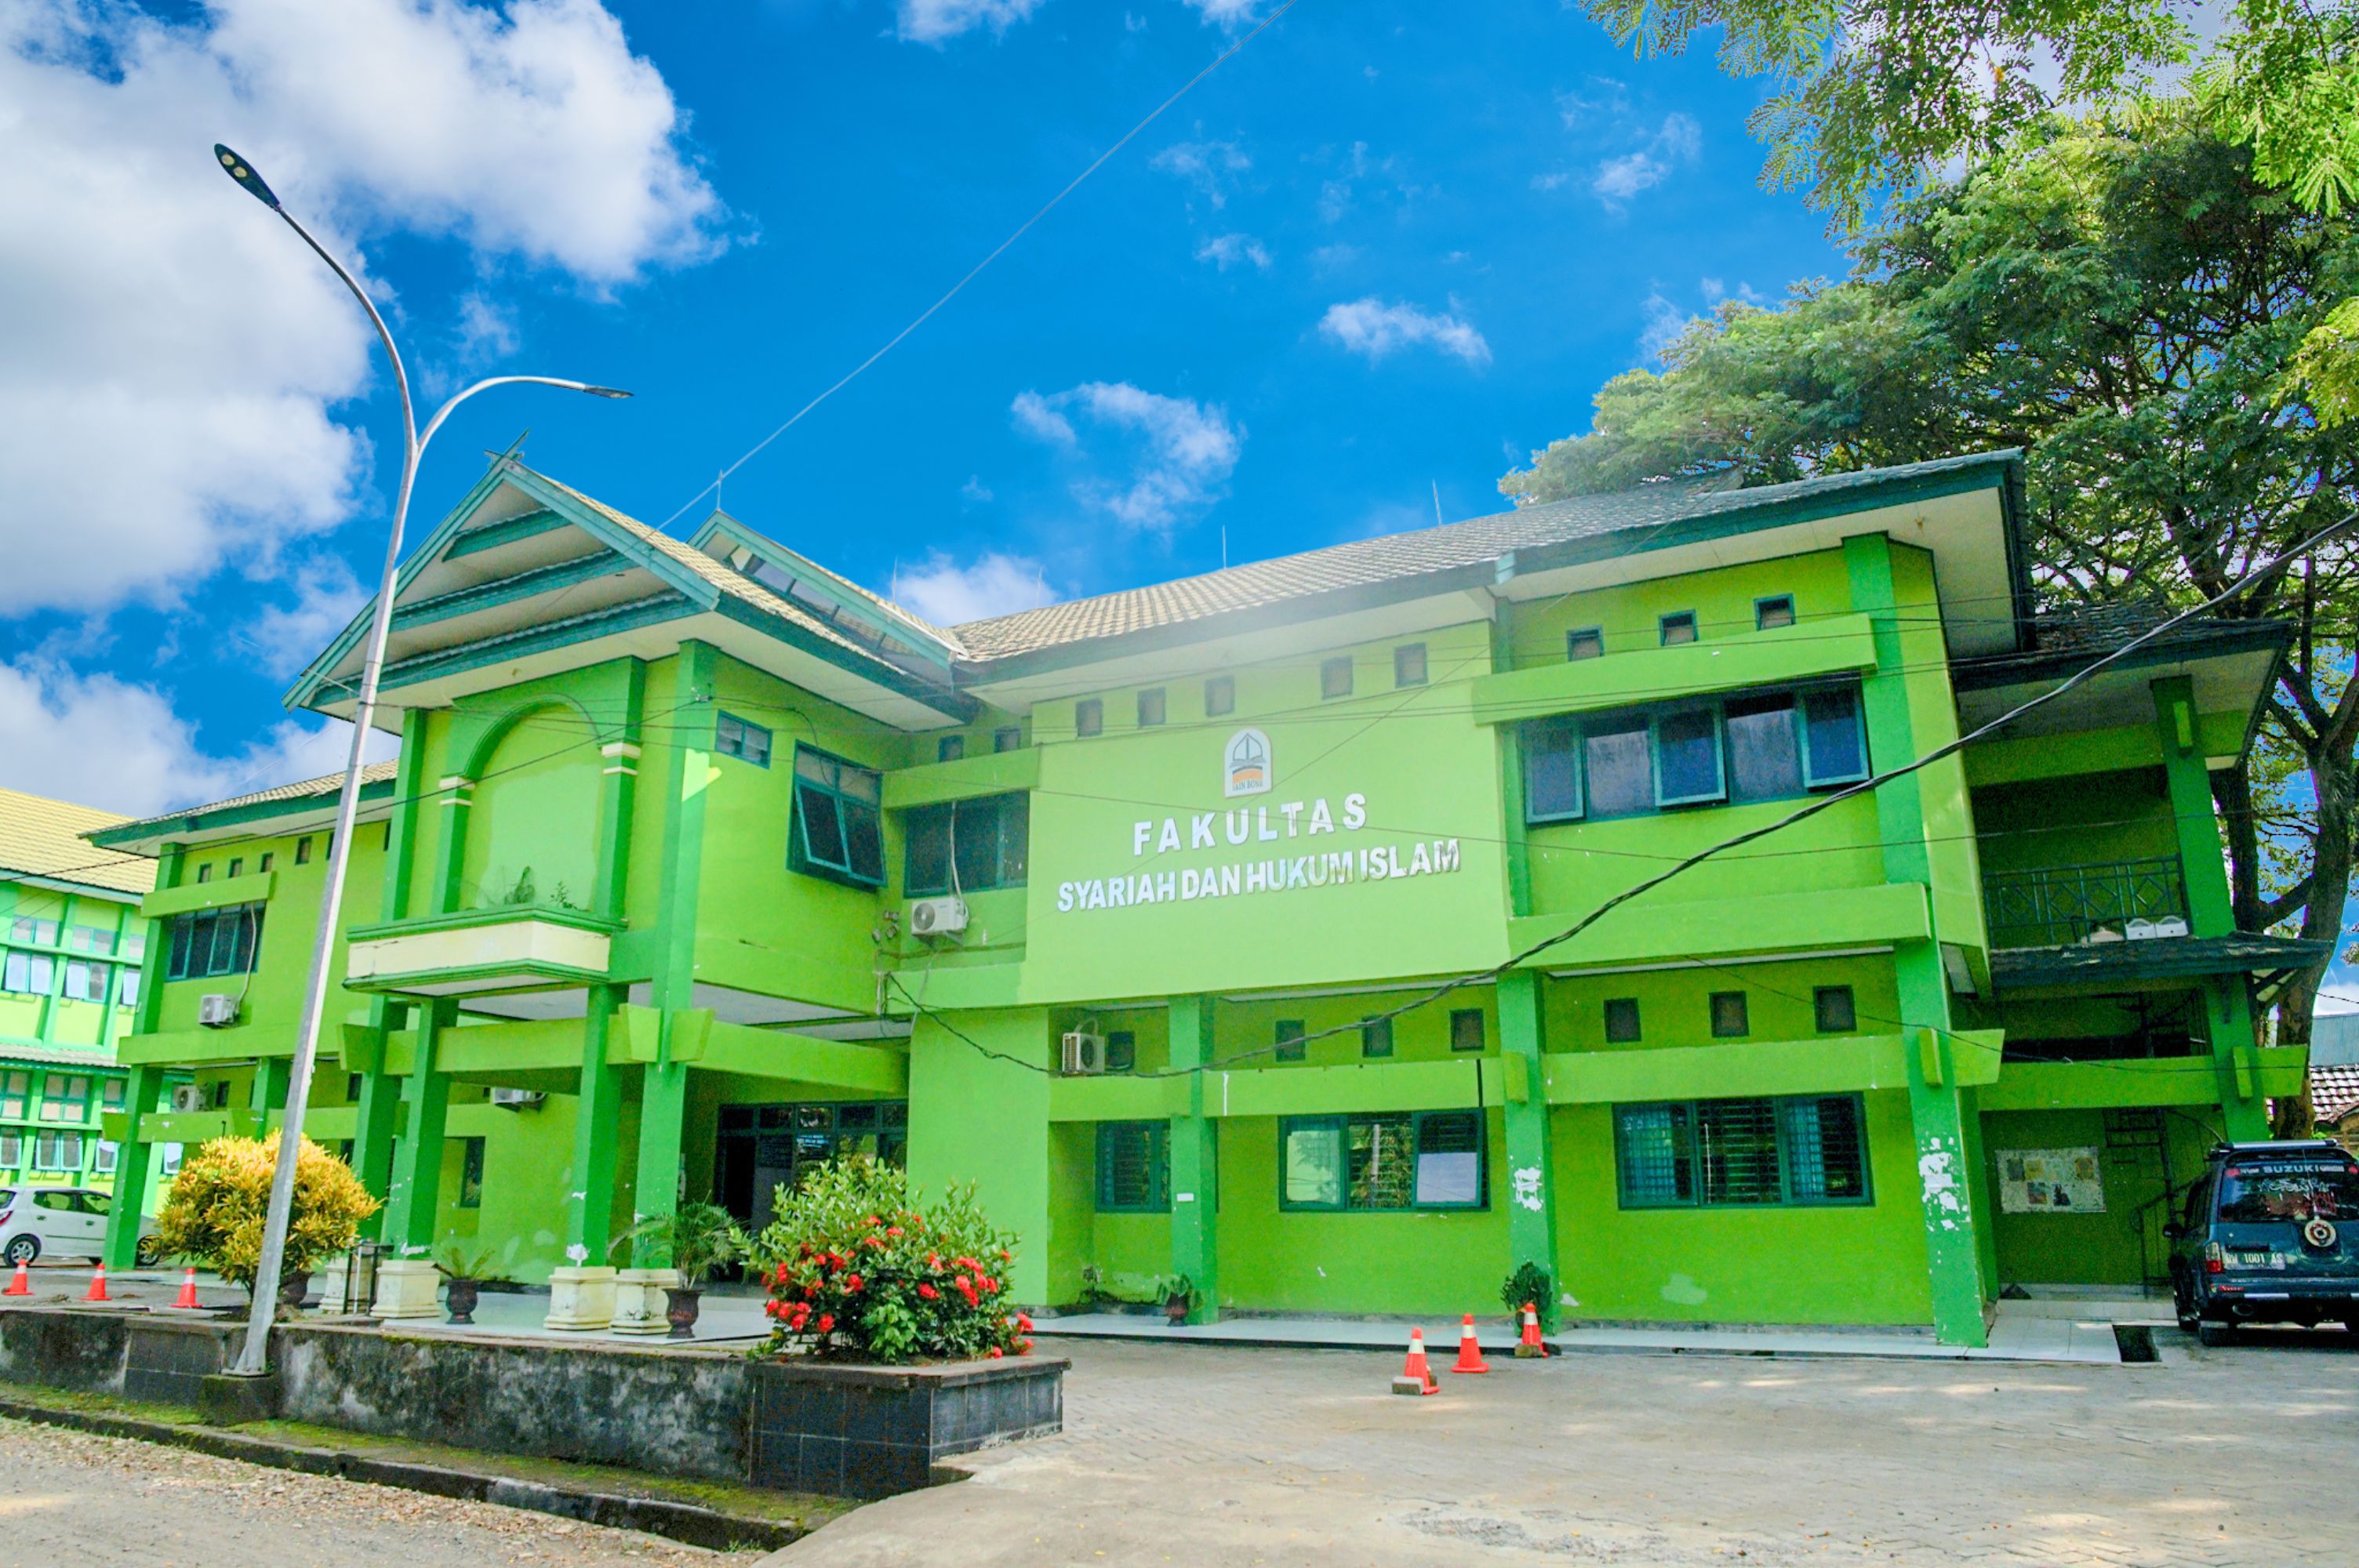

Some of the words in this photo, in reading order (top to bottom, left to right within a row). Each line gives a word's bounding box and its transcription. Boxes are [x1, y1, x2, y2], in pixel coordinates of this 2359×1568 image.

[1133, 793, 1368, 856] FAKULTAS
[1057, 870, 1176, 913] SYARIAH
[1181, 864, 1241, 901] DAN
[1246, 851, 1354, 894] HUKUM
[1360, 839, 1460, 882] ISLAM
[2263, 1164, 2319, 1174] SUZUKI
